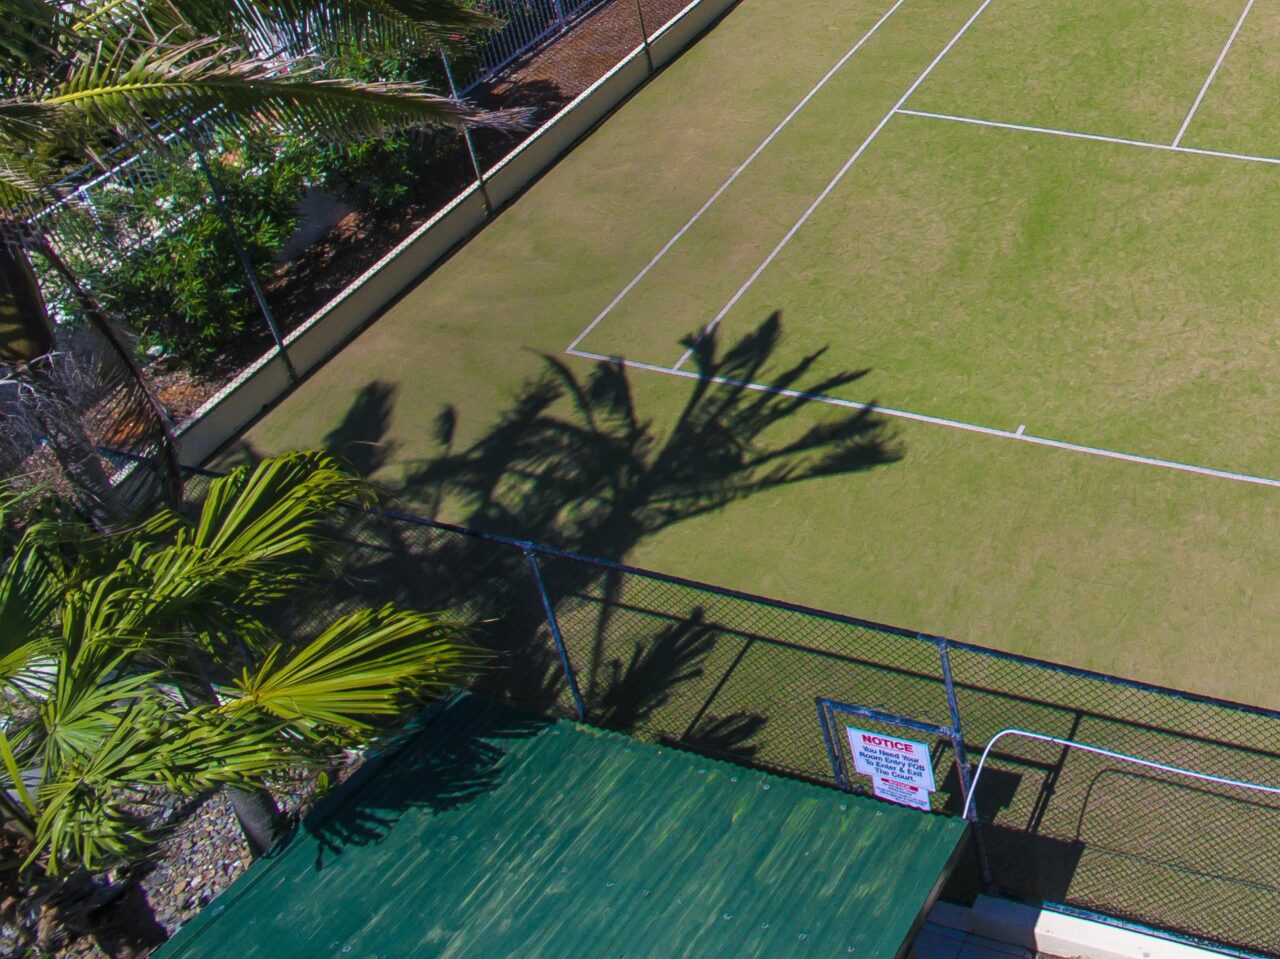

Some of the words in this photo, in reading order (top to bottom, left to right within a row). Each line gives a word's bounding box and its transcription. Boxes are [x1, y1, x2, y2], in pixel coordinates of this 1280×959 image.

[862, 734, 913, 753] NOTICE
[859, 752, 883, 761] Room
[885, 757, 906, 767] Entry
[908, 762, 925, 772] FOB
[863, 746, 877, 754] You
[879, 749, 900, 759] Need
[901, 754, 919, 763] Your
[874, 767, 889, 775] The
[876, 761, 897, 771] Enter
[907, 768, 923, 778] Exit
